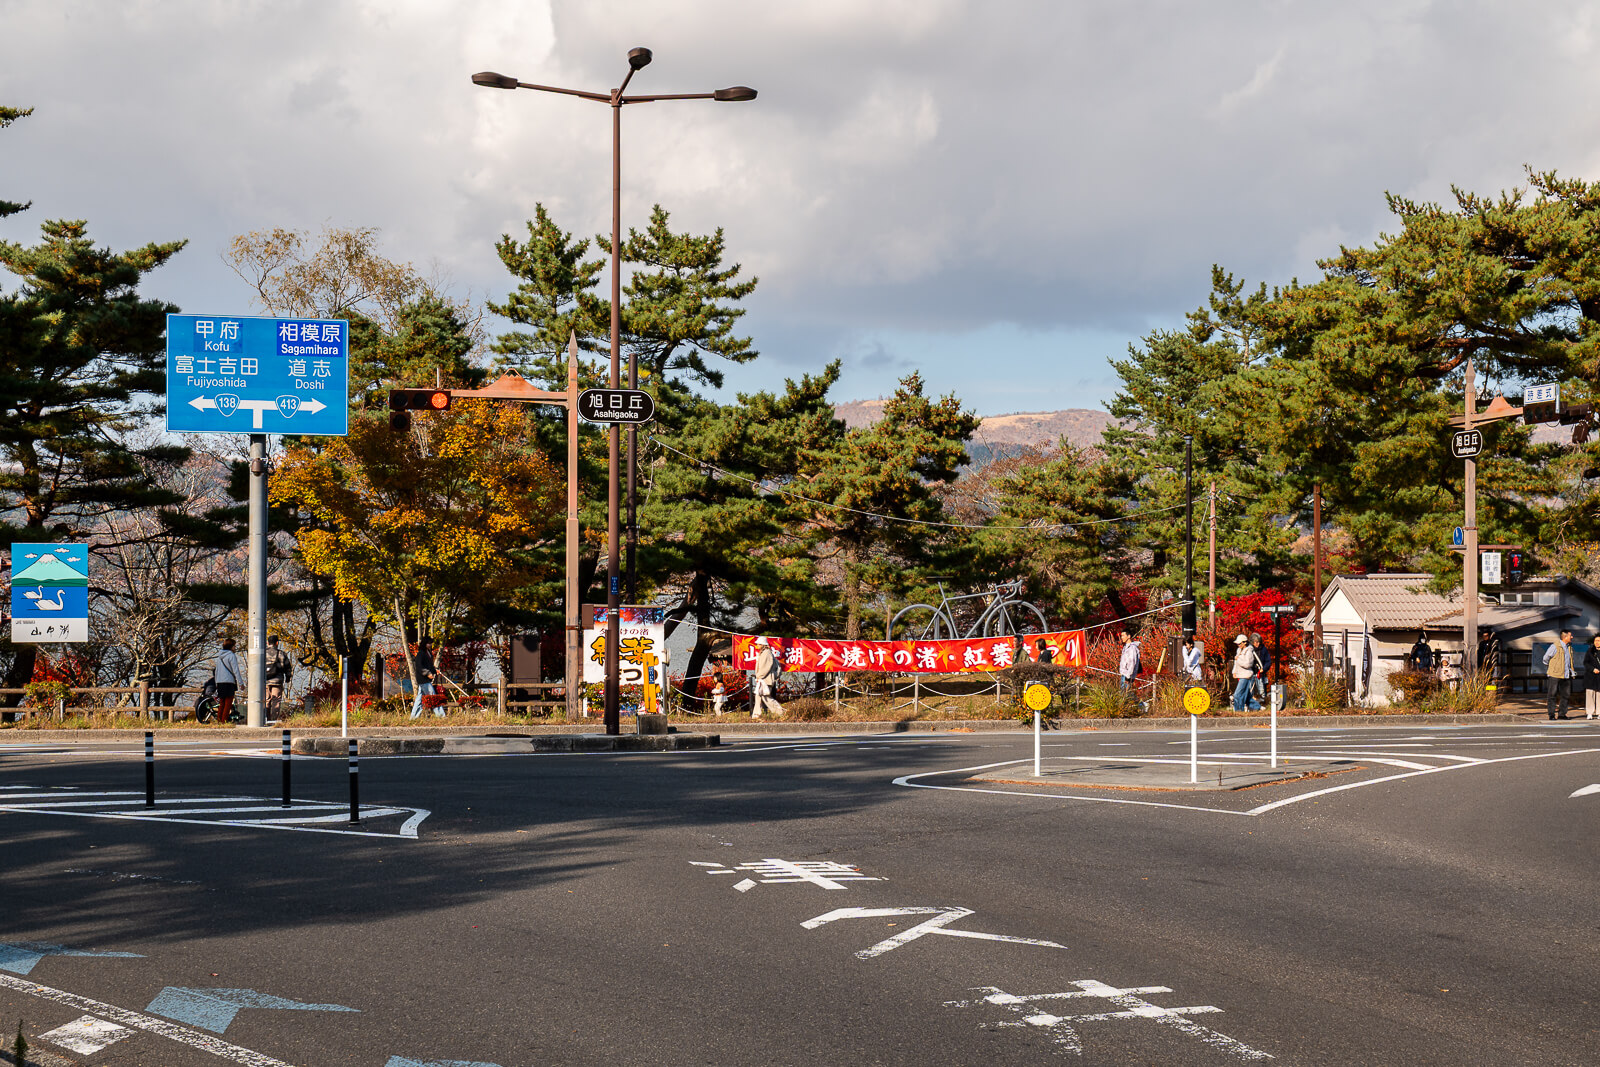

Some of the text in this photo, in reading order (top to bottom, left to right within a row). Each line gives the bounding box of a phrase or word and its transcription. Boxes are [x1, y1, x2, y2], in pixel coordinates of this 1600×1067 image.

[196, 320, 240, 340] 甲府
[279, 323, 341, 342] 相模原
[204, 342, 230, 352] Kofu
[281, 344, 339, 356] Sagamihara
[175, 355, 258, 376] 富士吉田
[288, 359, 332, 378] 道志
[187, 376, 246, 388] Fujiyoshida
[296, 379, 324, 390] Doshi
[218, 398, 236, 408] 138
[280, 398, 296, 410] 413
[588, 394, 643, 409] 旭日丘
[594, 410, 638, 419] Asahigaoka
[1456, 434, 1478, 447] 旭日丘
